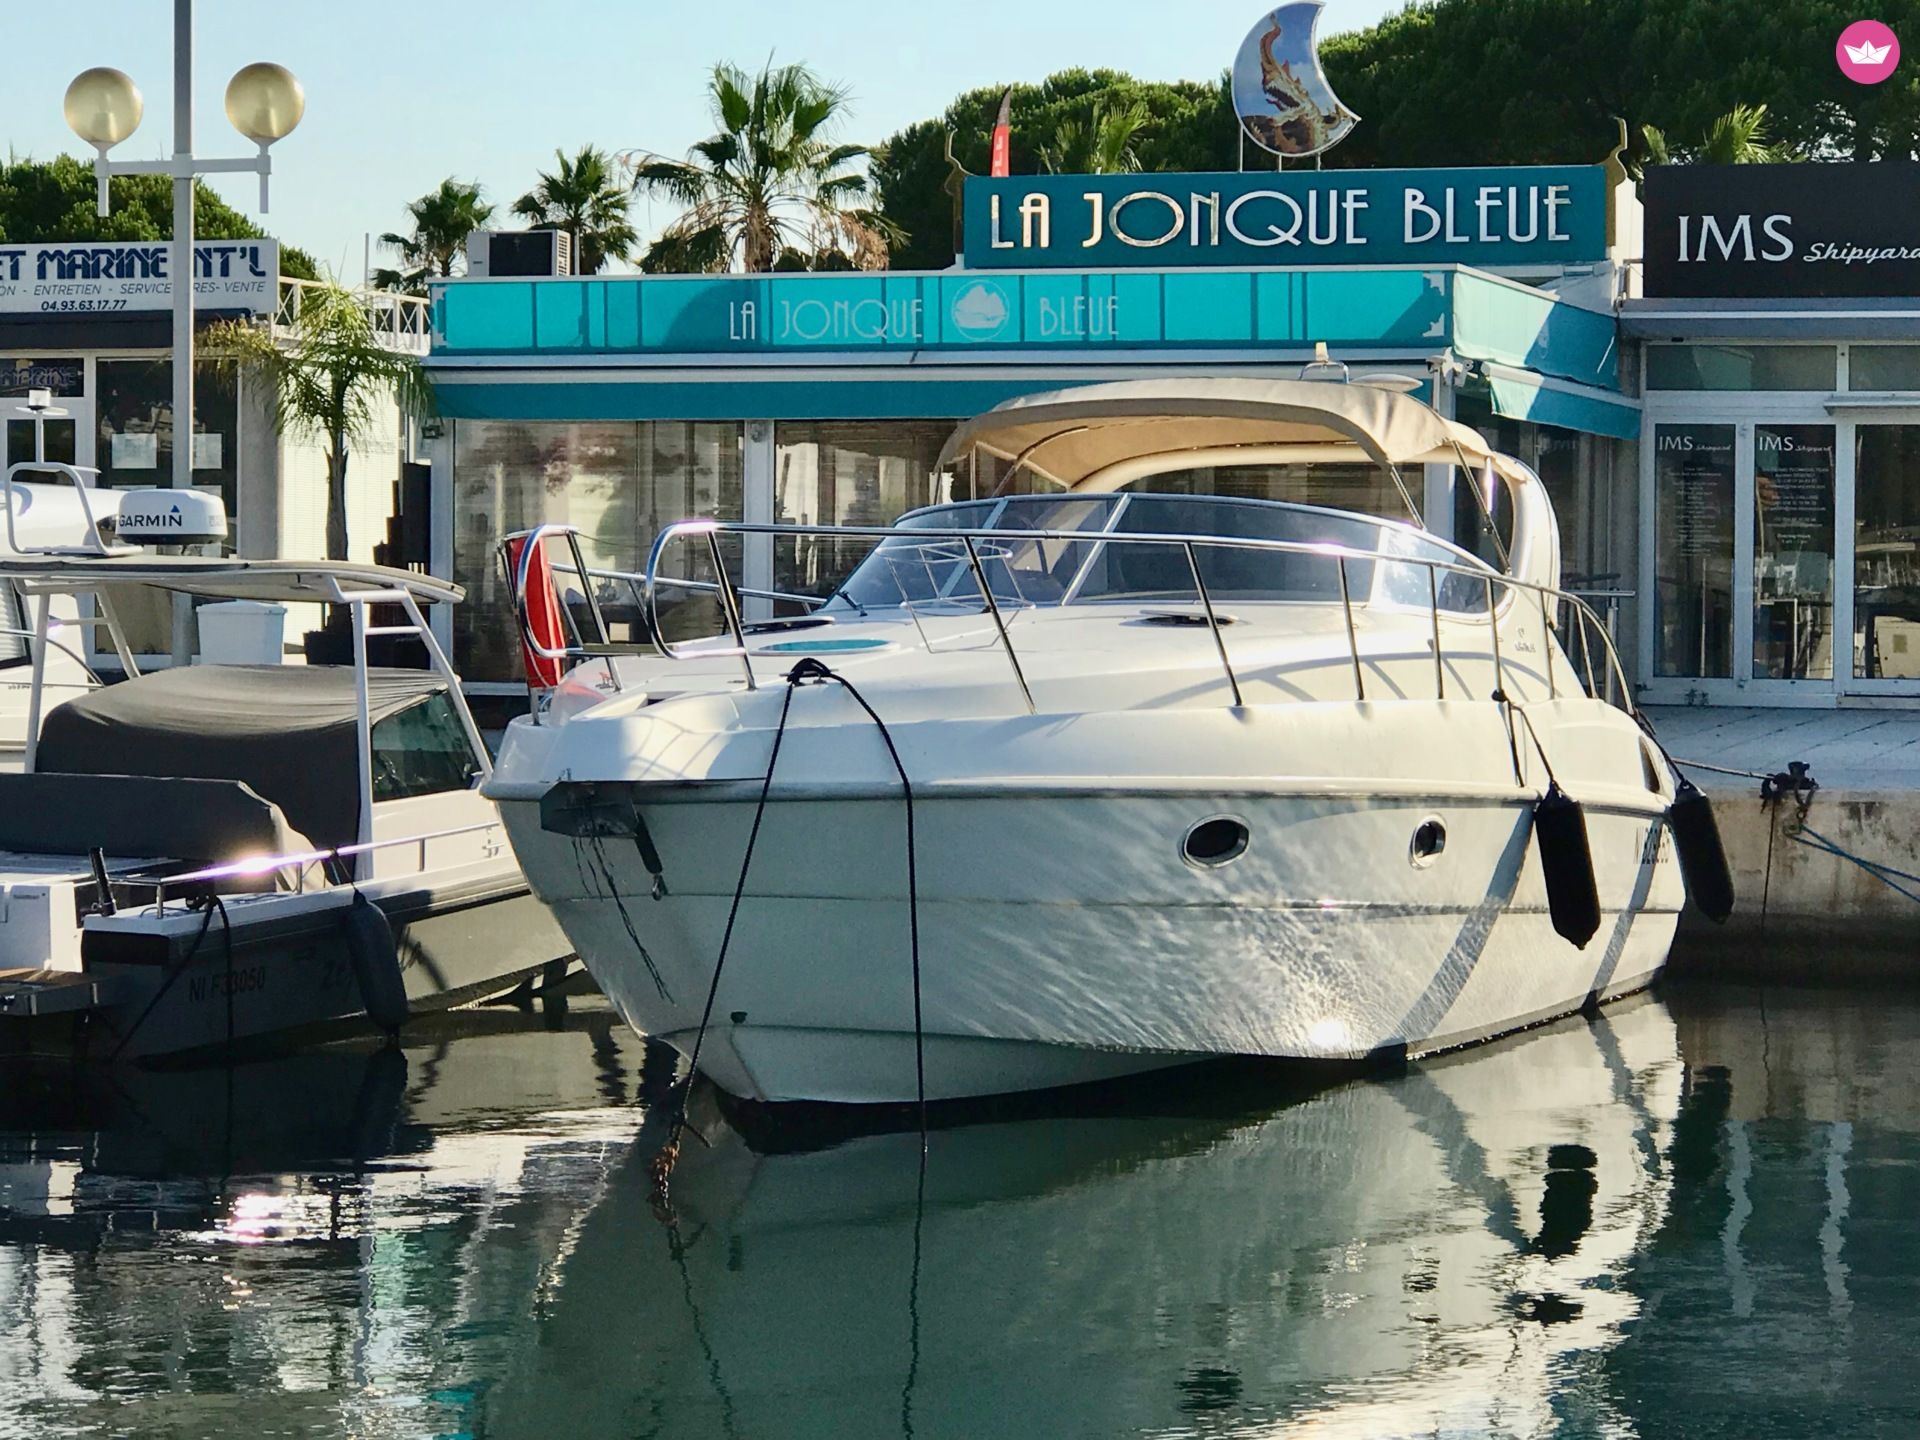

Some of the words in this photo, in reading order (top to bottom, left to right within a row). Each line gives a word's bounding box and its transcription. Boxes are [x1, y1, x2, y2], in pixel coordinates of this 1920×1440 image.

[991, 192, 1050, 248] LA
[1081, 189, 1369, 247] JONQUE
[1404, 185, 1572, 243] BLEUE
[1677, 214, 1794, 262] IMS
[37, 248, 168, 280] MARINE
[34, 283, 102, 296] ENTRETIEN
[224, 281, 266, 293] VENTE
[41, 300, 127, 312] 04.93.63.17.77
[729, 300, 756, 340] LA
[780, 299, 923, 339] JONQUE
[1040, 296, 1119, 337] BLEUE
[1659, 435, 1693, 451] IMS
[1759, 436, 1794, 451] IMS
[119, 514, 183, 528] GARMIN
